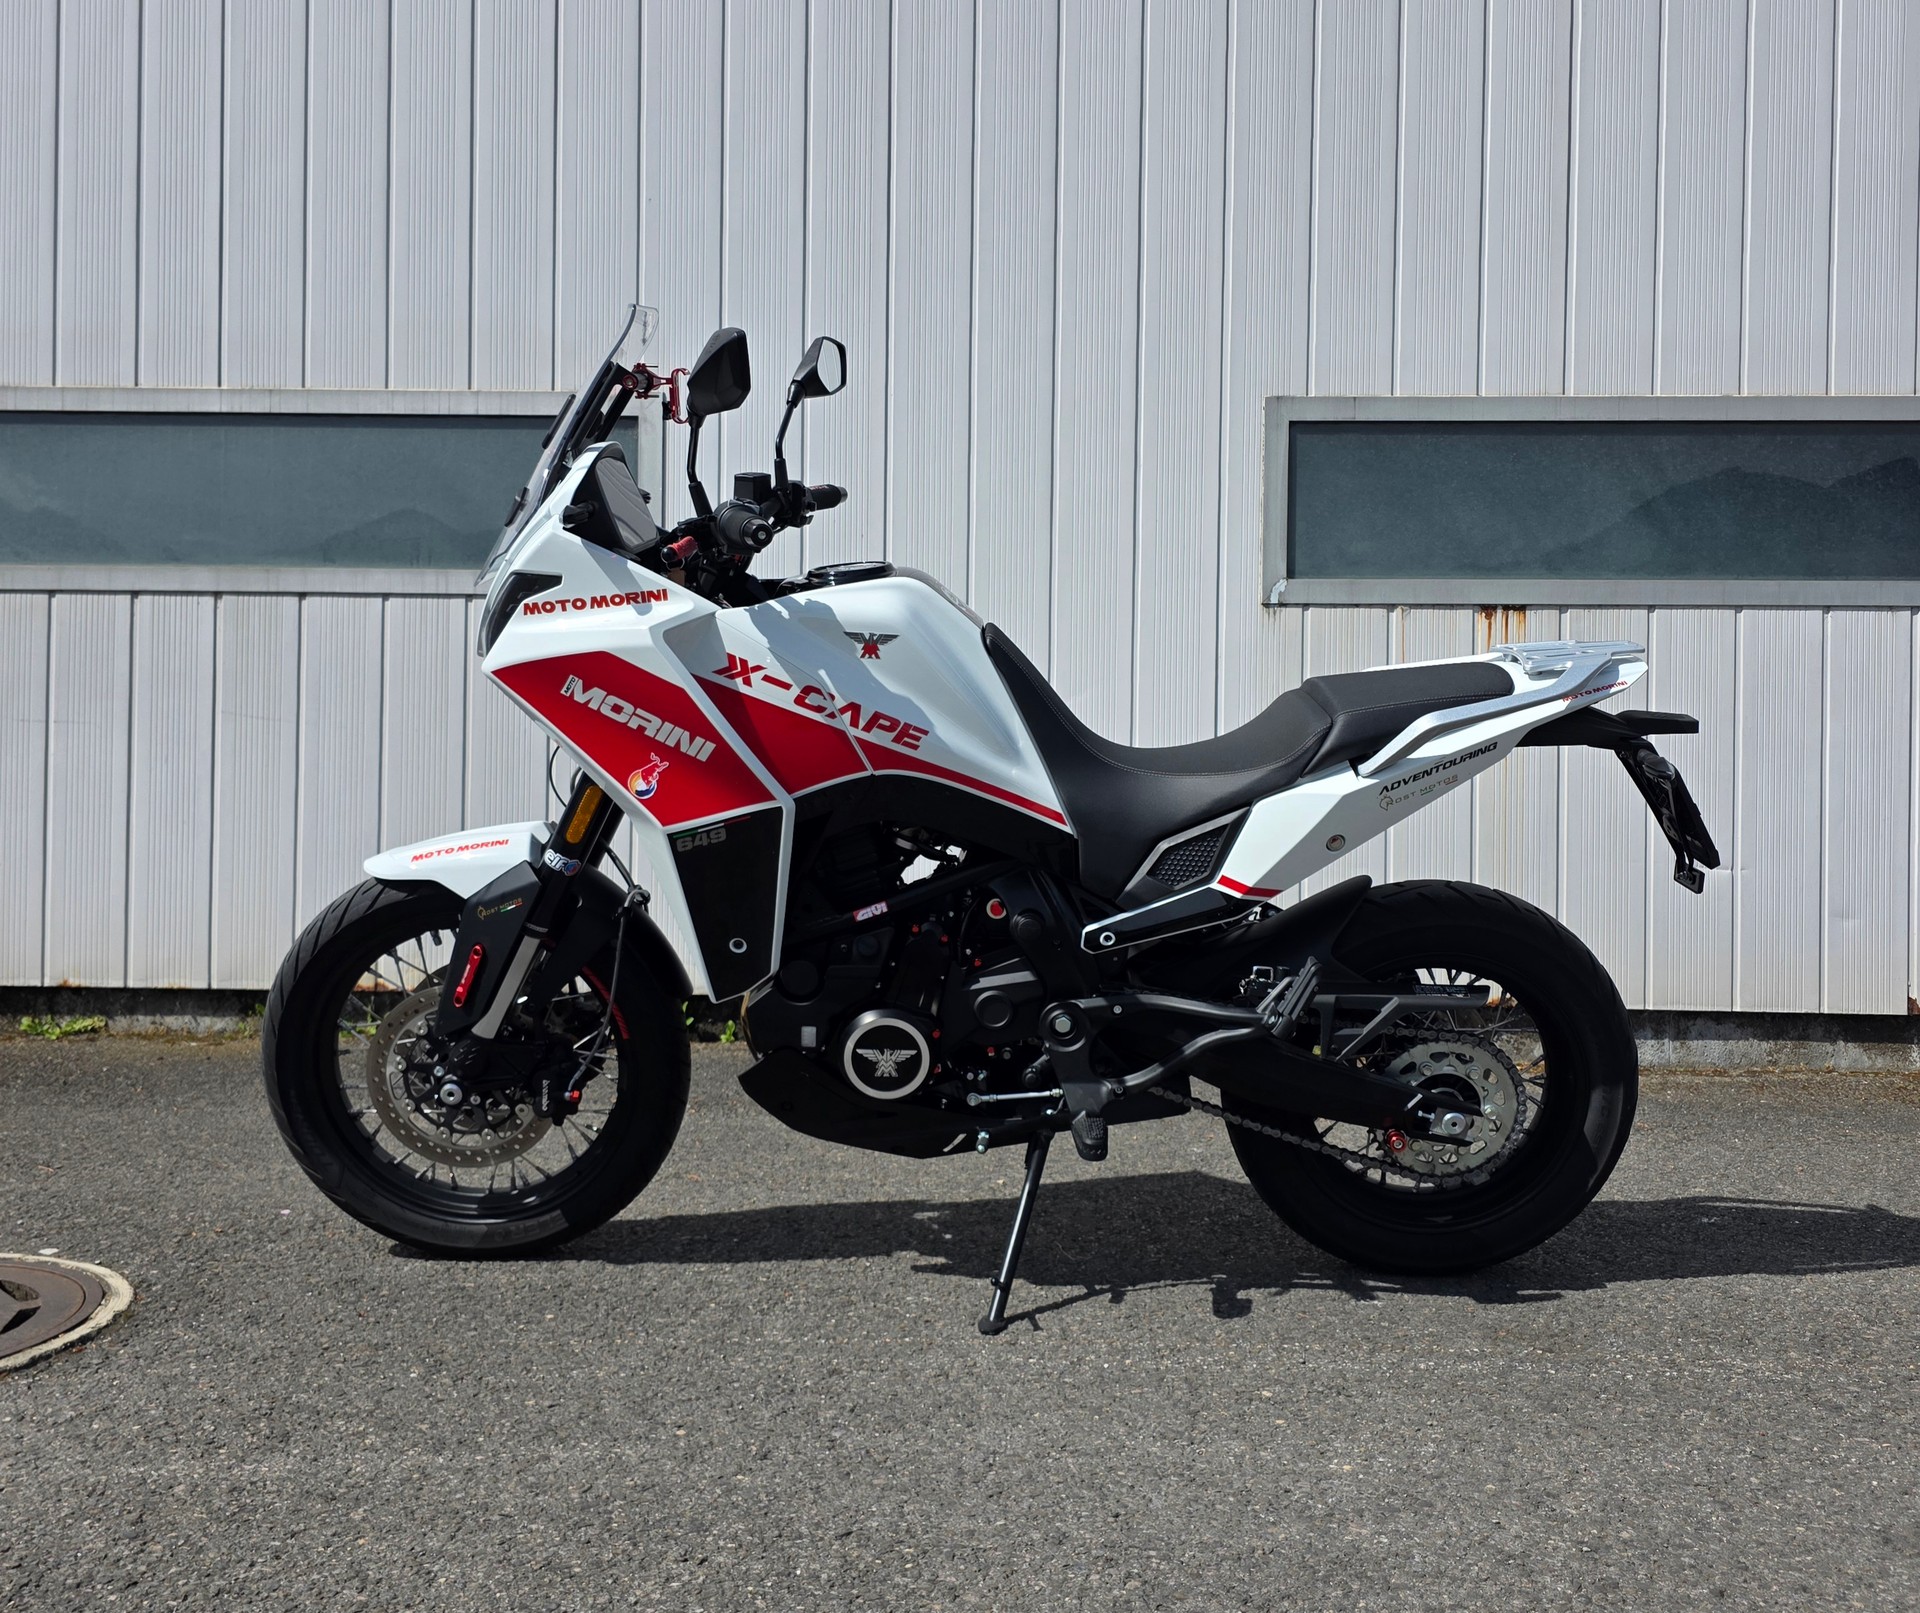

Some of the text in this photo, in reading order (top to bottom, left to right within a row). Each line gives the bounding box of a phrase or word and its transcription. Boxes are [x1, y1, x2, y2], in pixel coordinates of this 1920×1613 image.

[523, 588, 669, 616] MOTO MORINI
[564, 677, 577, 695] MOTO
[712, 652, 930, 750] X-CAPE
[572, 678, 717, 762] MORINI
[1380, 741, 1498, 795] ADVENTOURING
[1420, 774, 1458, 793] MOTOS
[411, 839, 510, 863] MOTO MORINI
[676, 827, 727, 852] 649
[545, 850, 569, 871] elf
